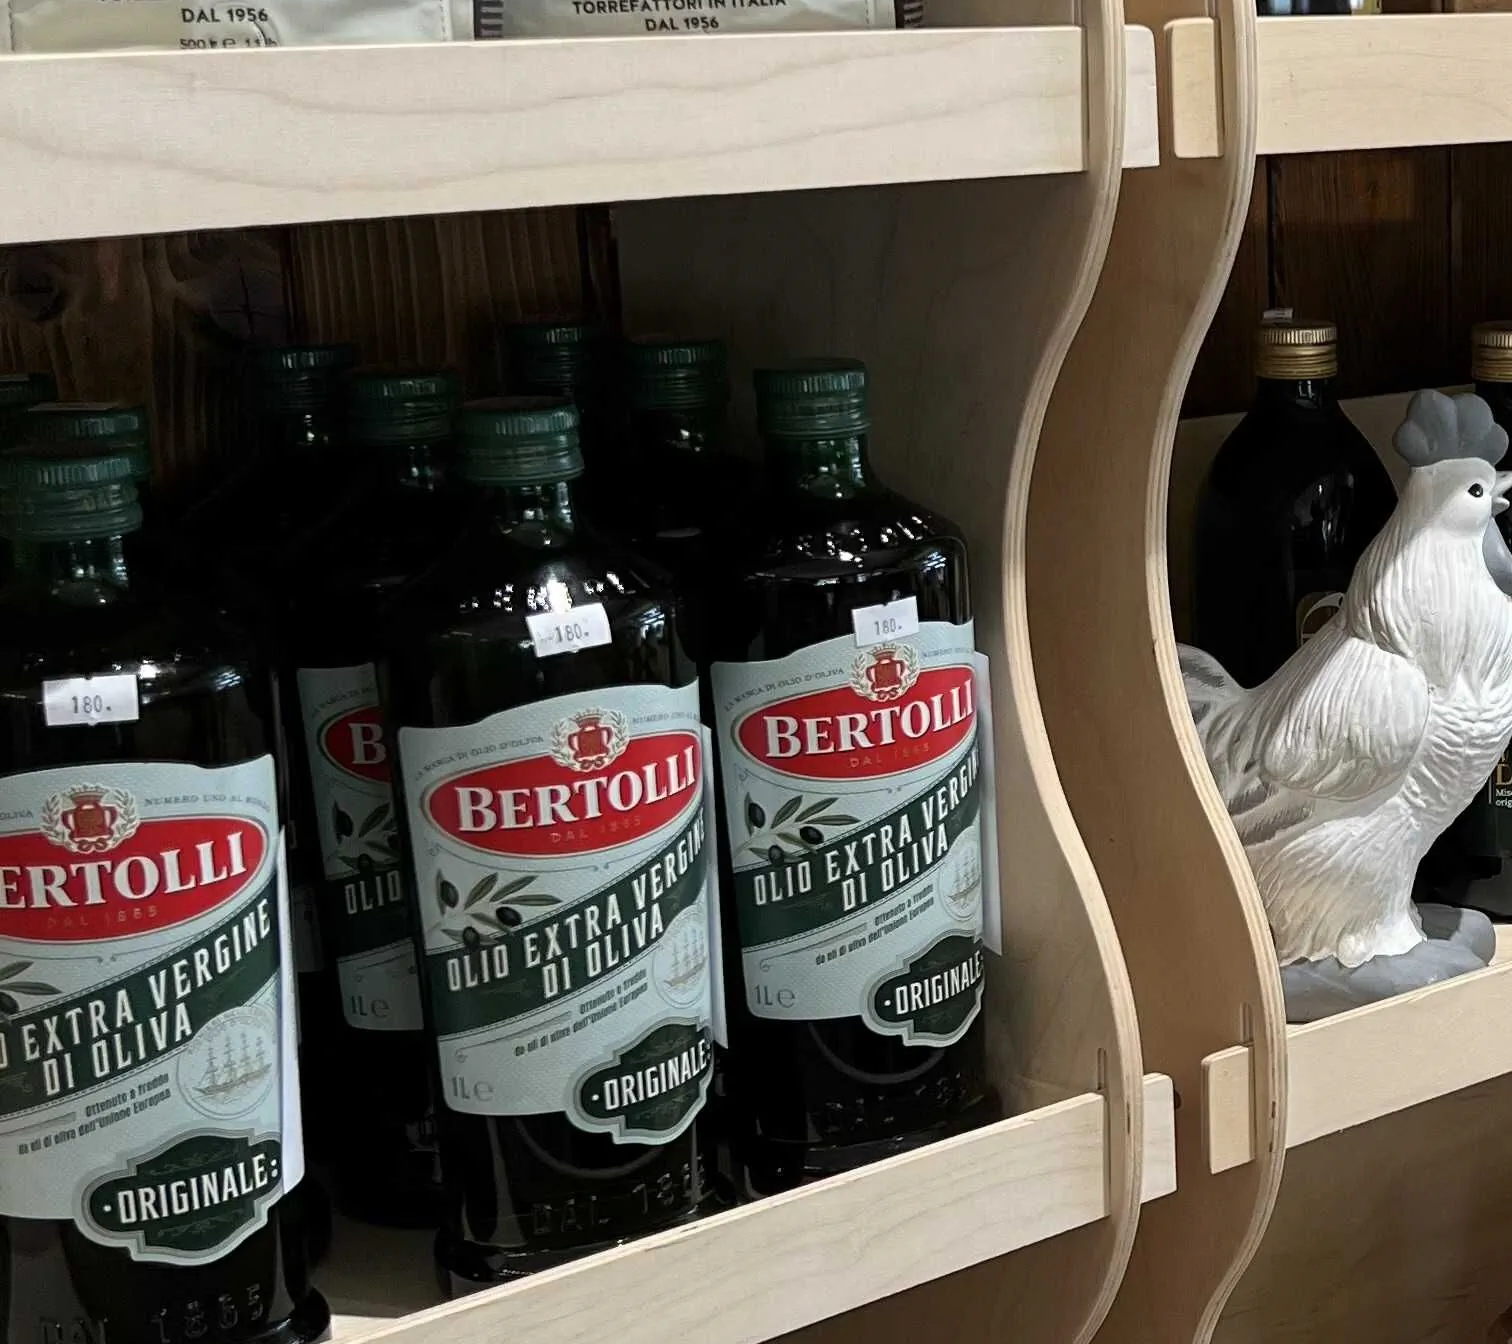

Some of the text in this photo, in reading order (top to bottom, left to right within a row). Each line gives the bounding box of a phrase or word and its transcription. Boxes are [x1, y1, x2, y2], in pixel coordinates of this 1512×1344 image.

[181, 8, 268, 23] DAL 1956
[645, 16, 719, 31] DAL 1956
[763, 680, 975, 758] BERTOLLI
[454, 745, 696, 832] BERTOLLI
[0, 831, 247, 909] ERTOLLI
[753, 815, 912, 906] OLIO EXTRA
[842, 823, 949, 912] DI OLIVA
[23, 898, 272, 1063] EXTRA VERGINE
[446, 896, 623, 991] OLIO EXTRA
[542, 902, 665, 1000] DI OLIVA
[895, 949, 982, 1015] ORIGINALE
[41, 1002, 193, 1098] DI OLIVA
[604, 1038, 707, 1111] ORIGINALE
[117, 1152, 269, 1224] ORIGINALE
